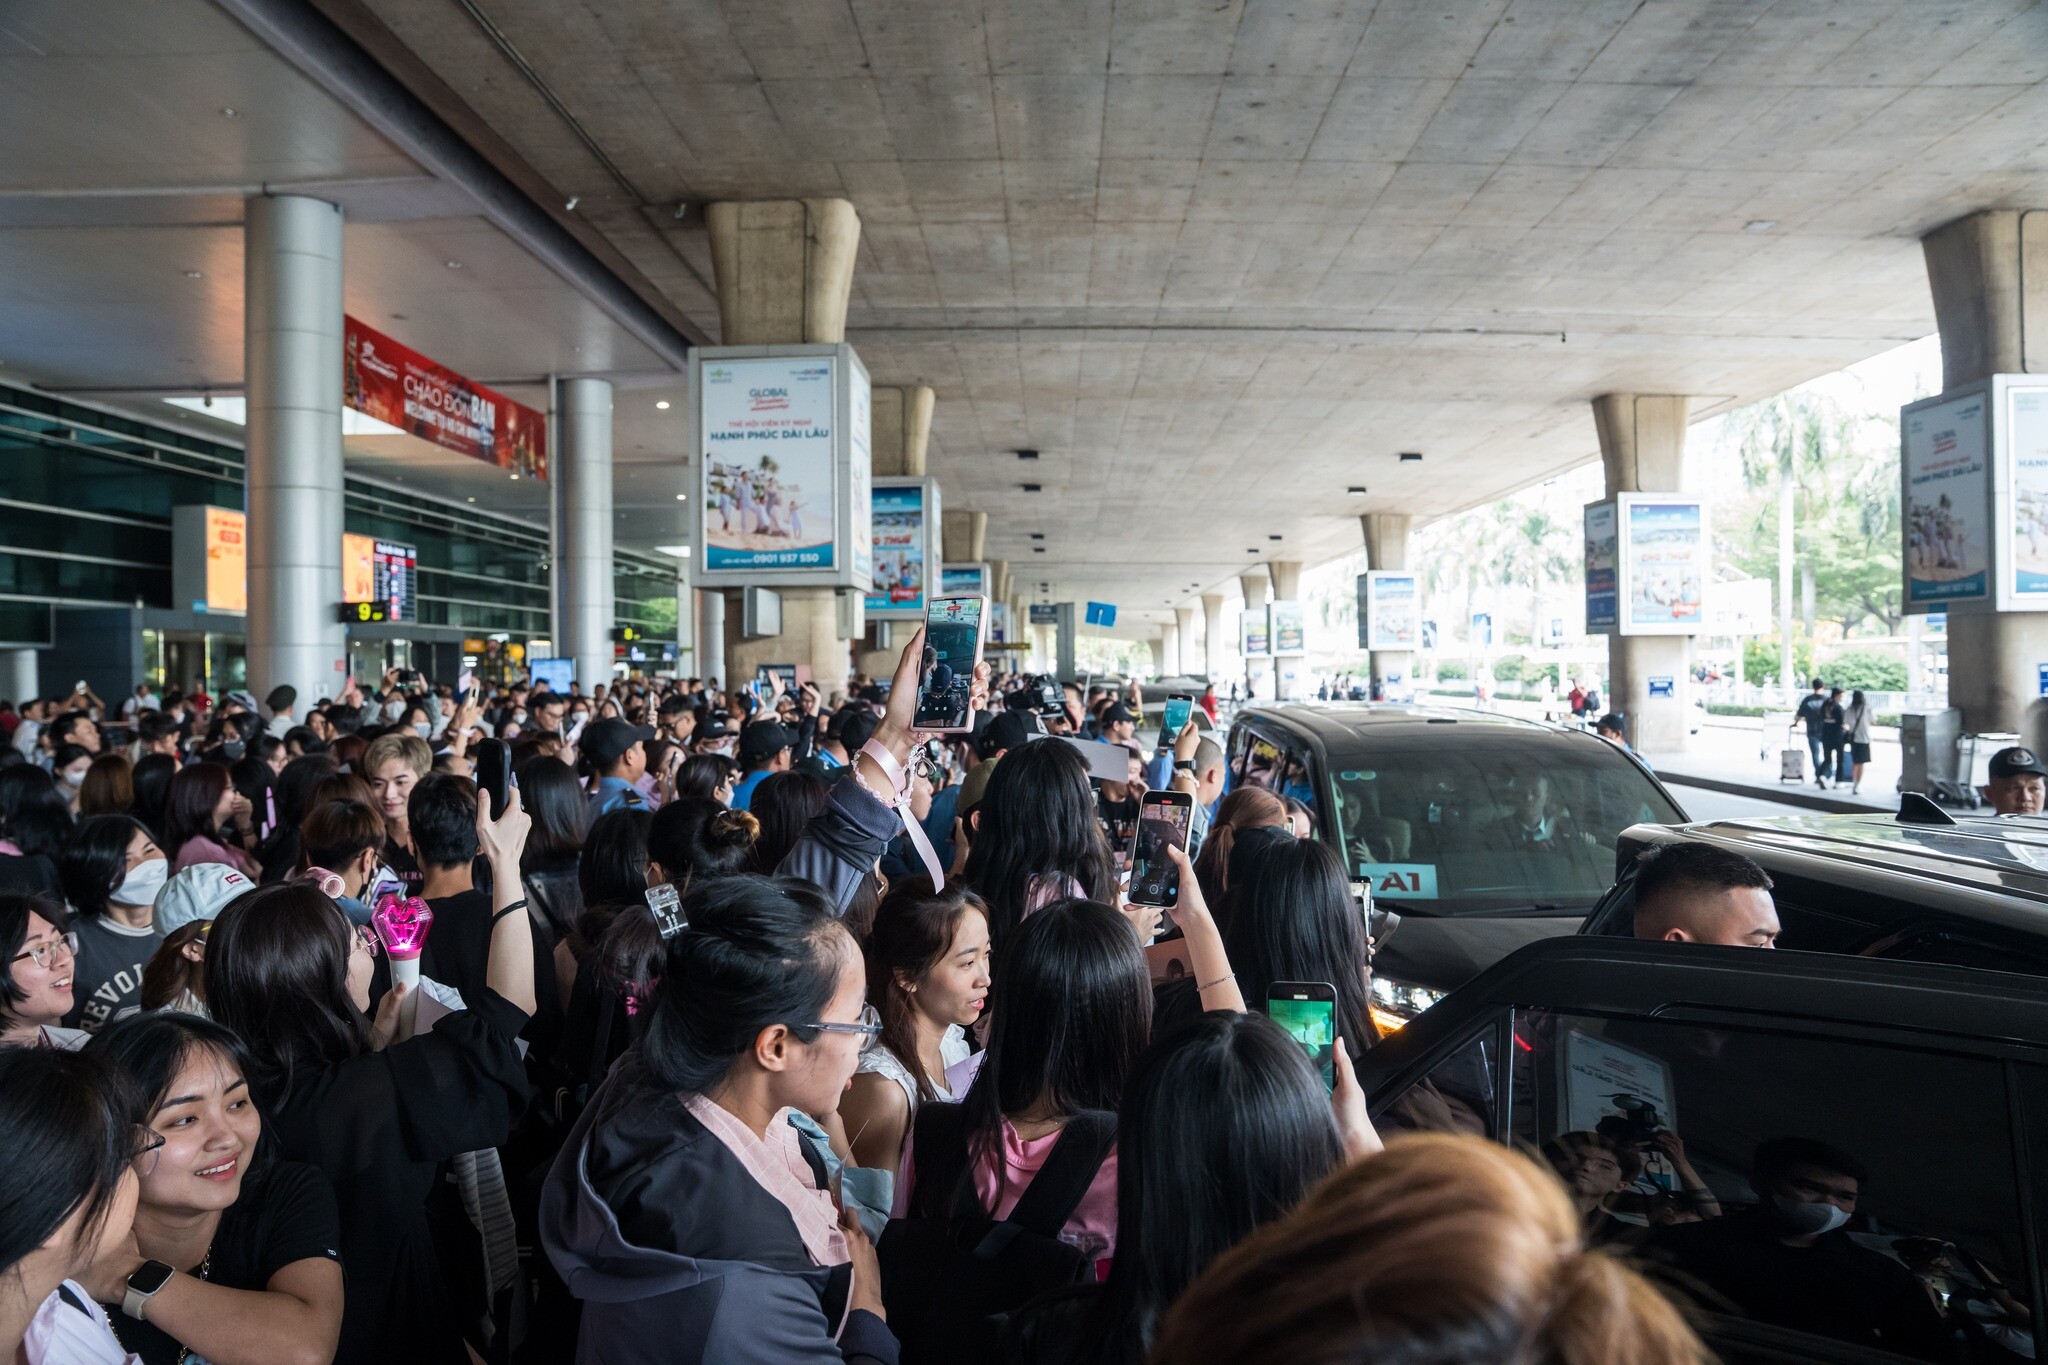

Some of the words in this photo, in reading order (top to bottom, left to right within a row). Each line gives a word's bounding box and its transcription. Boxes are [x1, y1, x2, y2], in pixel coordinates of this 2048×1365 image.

[749, 388, 788, 397] GLOBAL
[747, 428, 778, 440] PHÚC
[753, 554, 778, 563] 0901
[779, 553, 798, 563] 937
[799, 552, 820, 563] 550
[358, 603, 371, 621] 9
[1378, 872, 1421, 891] A1
